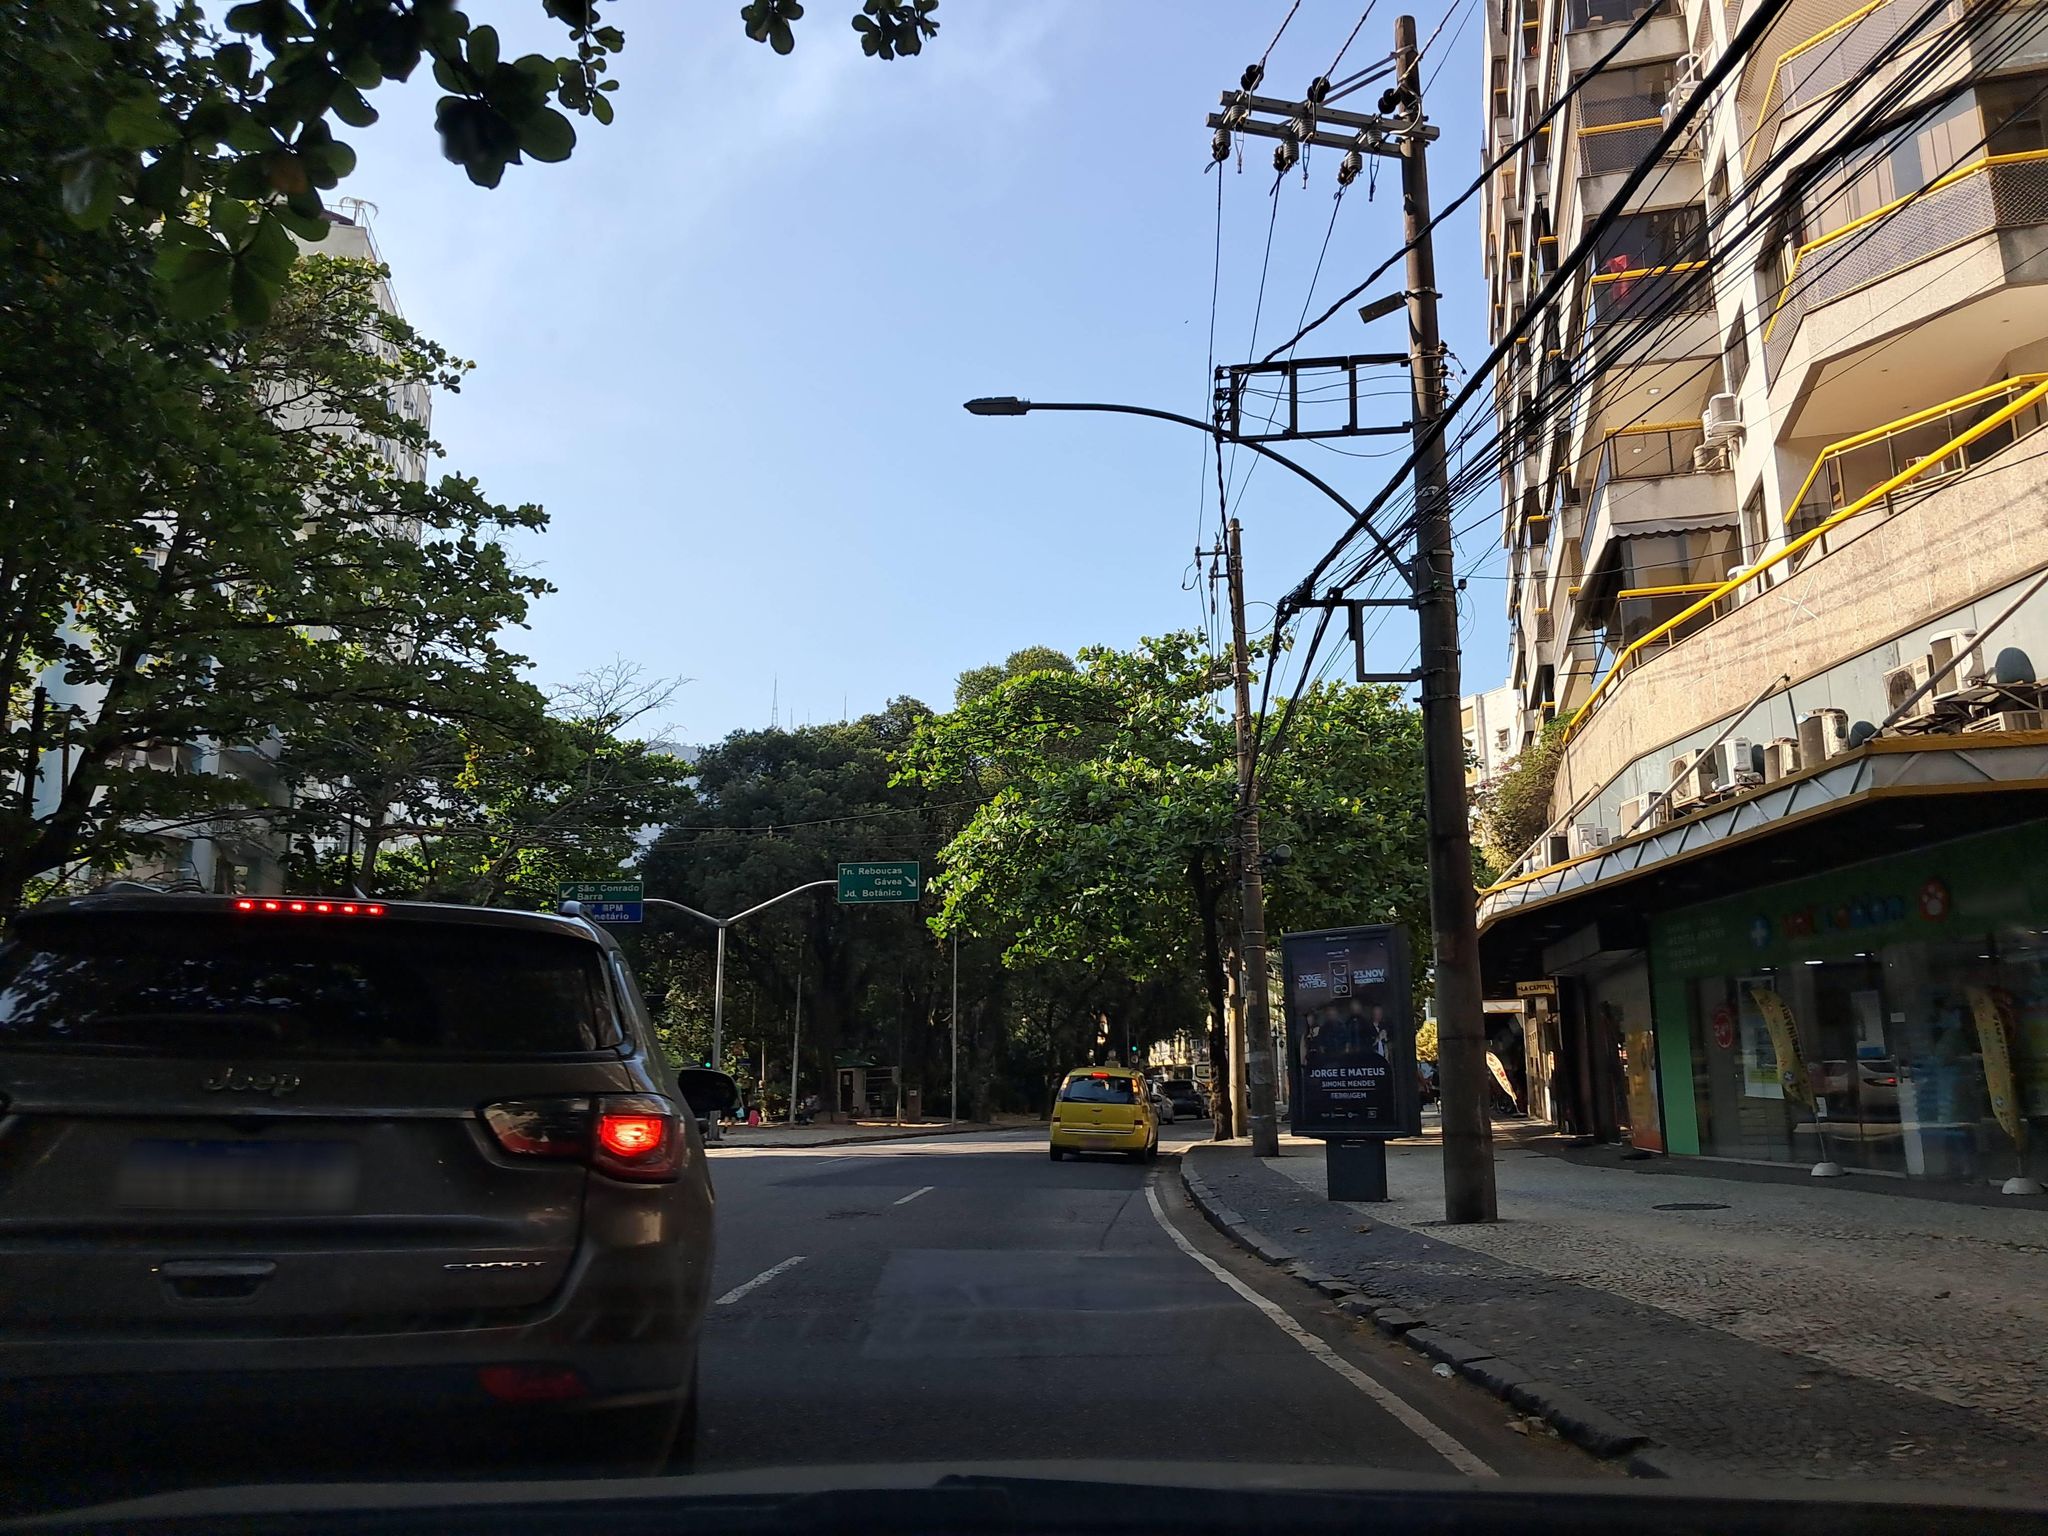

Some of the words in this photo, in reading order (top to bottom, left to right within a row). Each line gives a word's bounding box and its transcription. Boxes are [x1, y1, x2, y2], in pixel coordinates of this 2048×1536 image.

[874, 878, 902, 886] Gávea
[577, 884, 595, 892] São
[600, 884, 640, 892] Conrado
[577, 893, 604, 901] Barra
[862, 889, 902, 897] Botânico
[1309, 1068, 1339, 1078] JORGE
[1340, 1068, 1346, 1077] E
[1348, 1067, 1385, 1077] MATEUS
[1321, 1080, 1347, 1088] SIMONE
